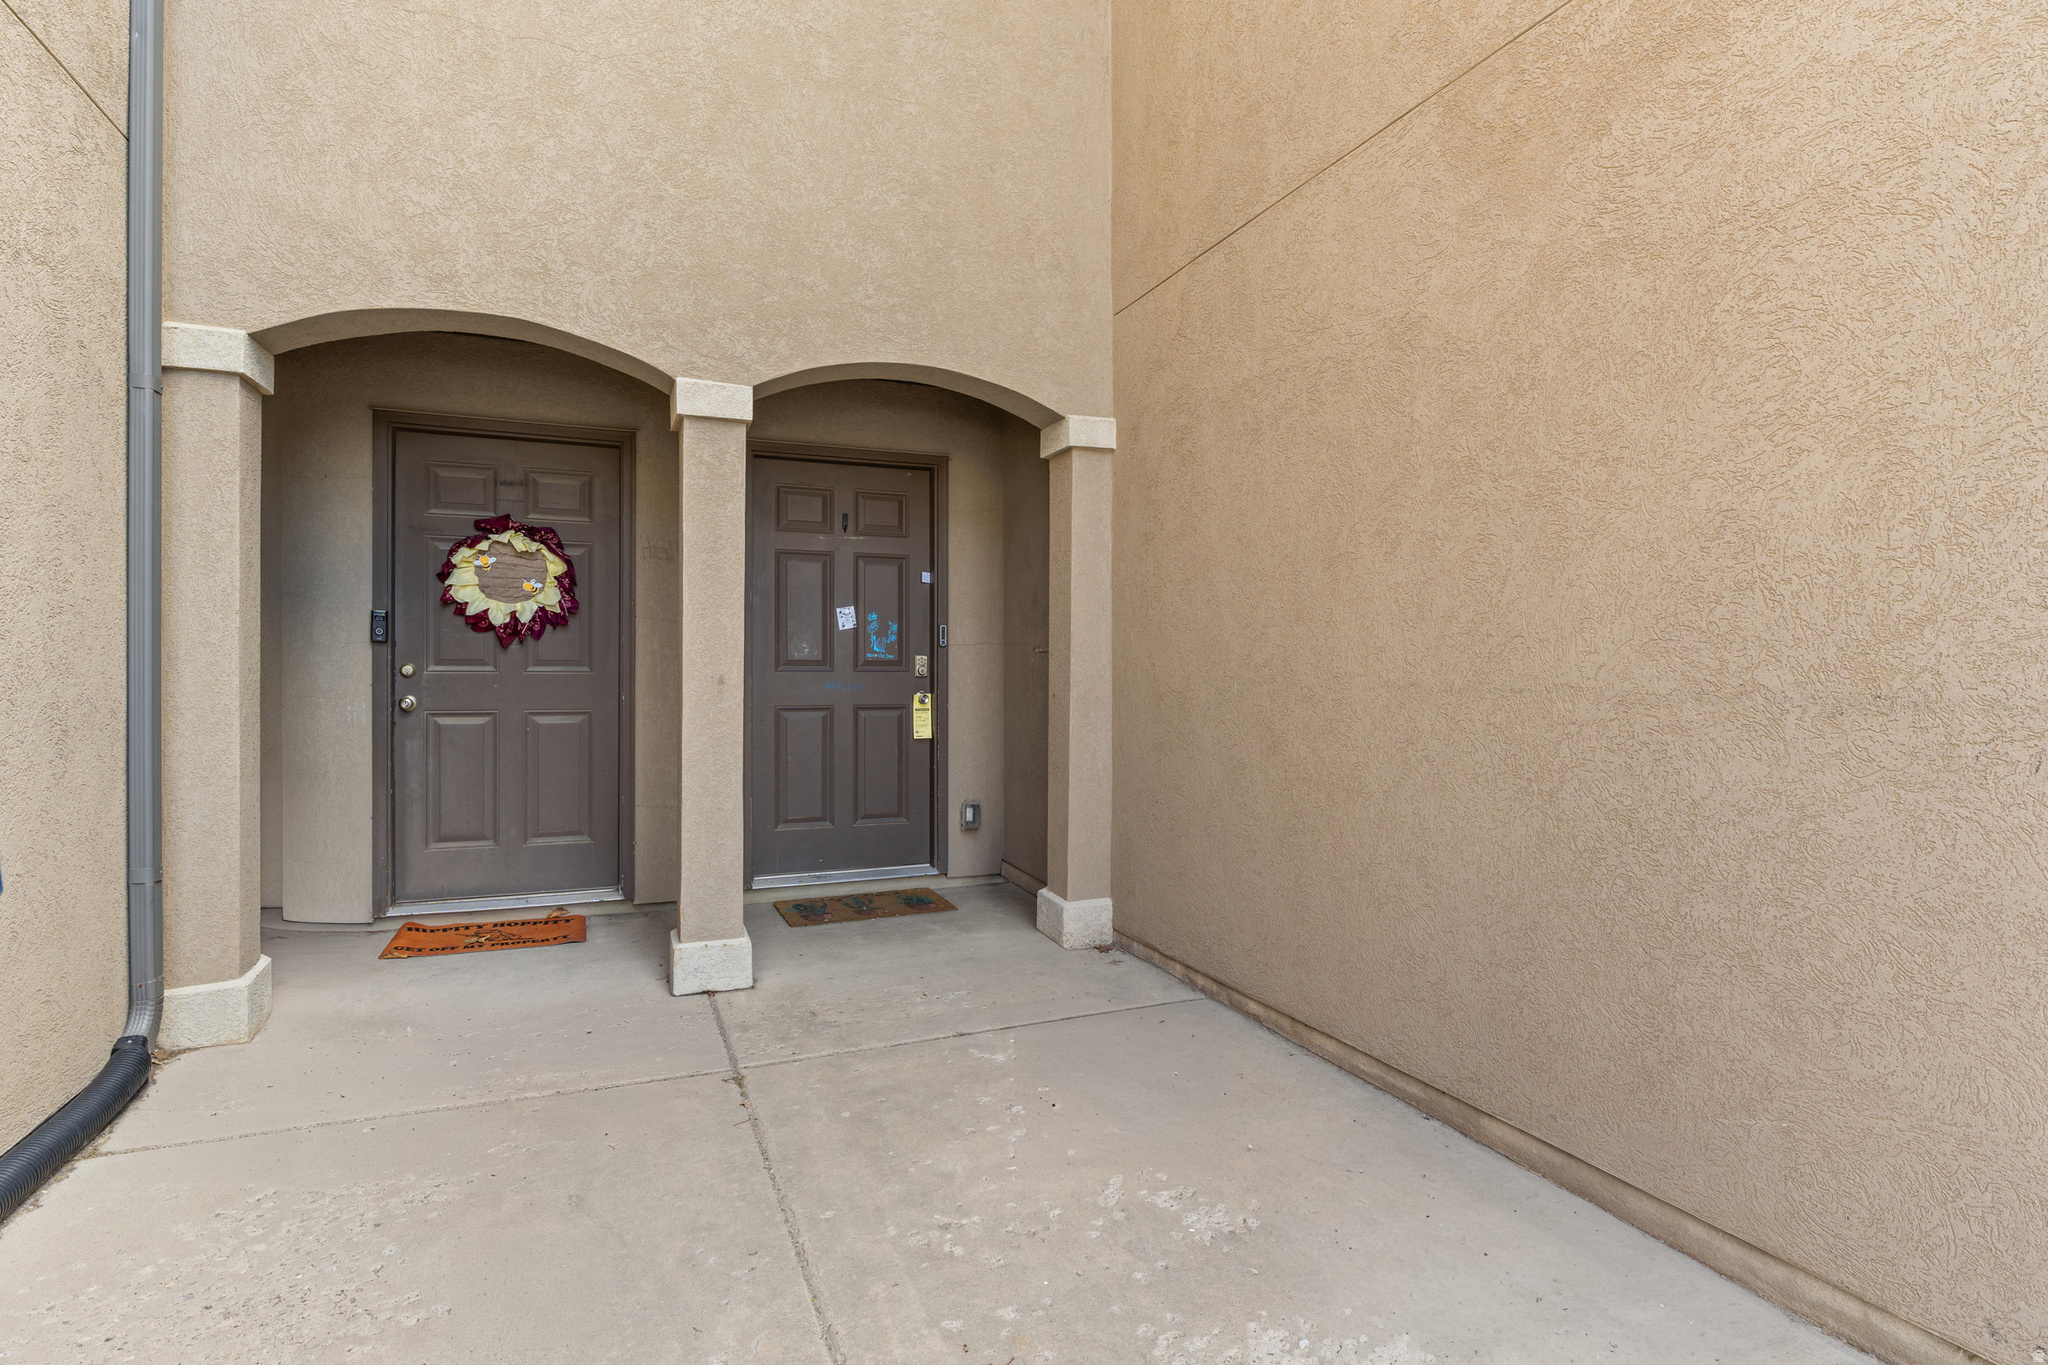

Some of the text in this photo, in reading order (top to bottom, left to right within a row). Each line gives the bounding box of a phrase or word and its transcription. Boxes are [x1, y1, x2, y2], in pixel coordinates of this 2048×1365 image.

[406, 918, 576, 933] HIPPITY HOPPITY
[490, 934, 571, 947] PROPERTY
